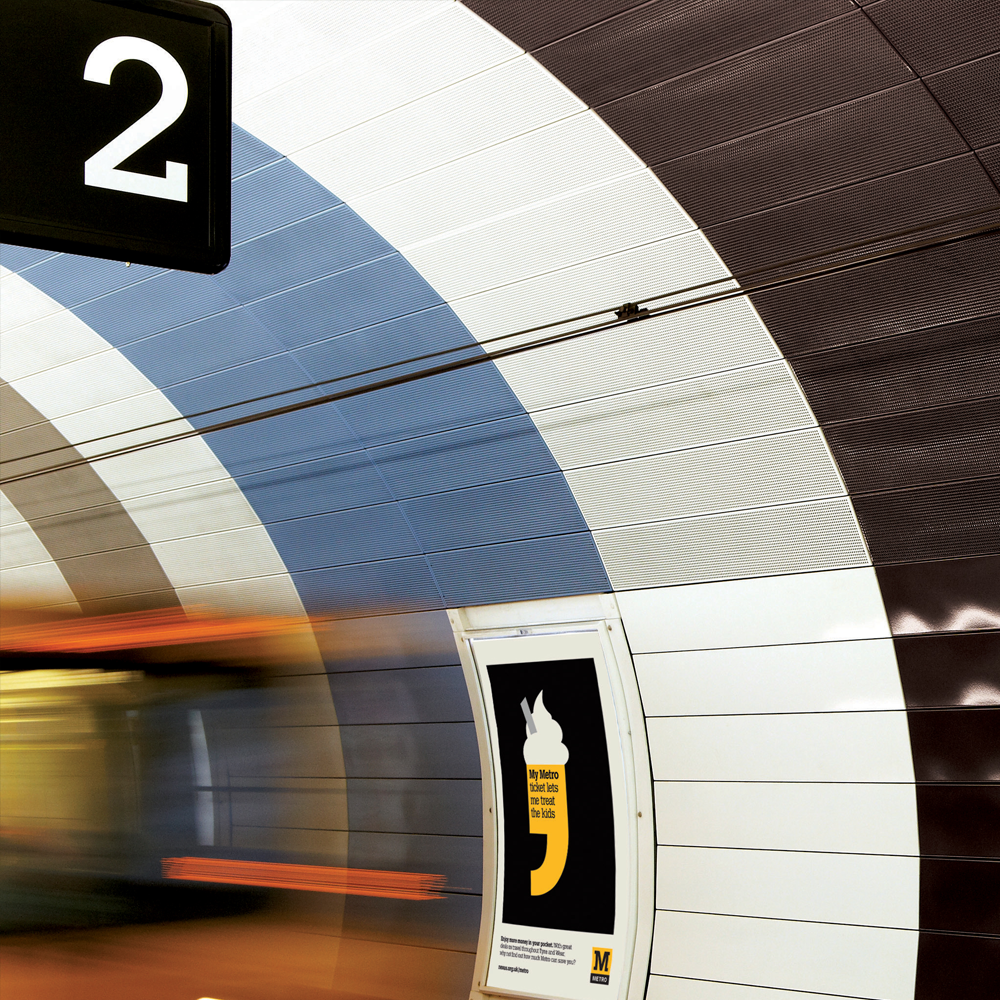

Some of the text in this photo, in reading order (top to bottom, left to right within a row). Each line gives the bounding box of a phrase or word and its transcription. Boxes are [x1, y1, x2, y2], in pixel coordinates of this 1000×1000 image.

[83, 36, 189, 203] 2
[529, 770, 559, 781] My Metro
[530, 782, 558, 792] ticket lets
[530, 796, 556, 806] me treat
[530, 808, 556, 818] the kids
[594, 950, 610, 972] M
